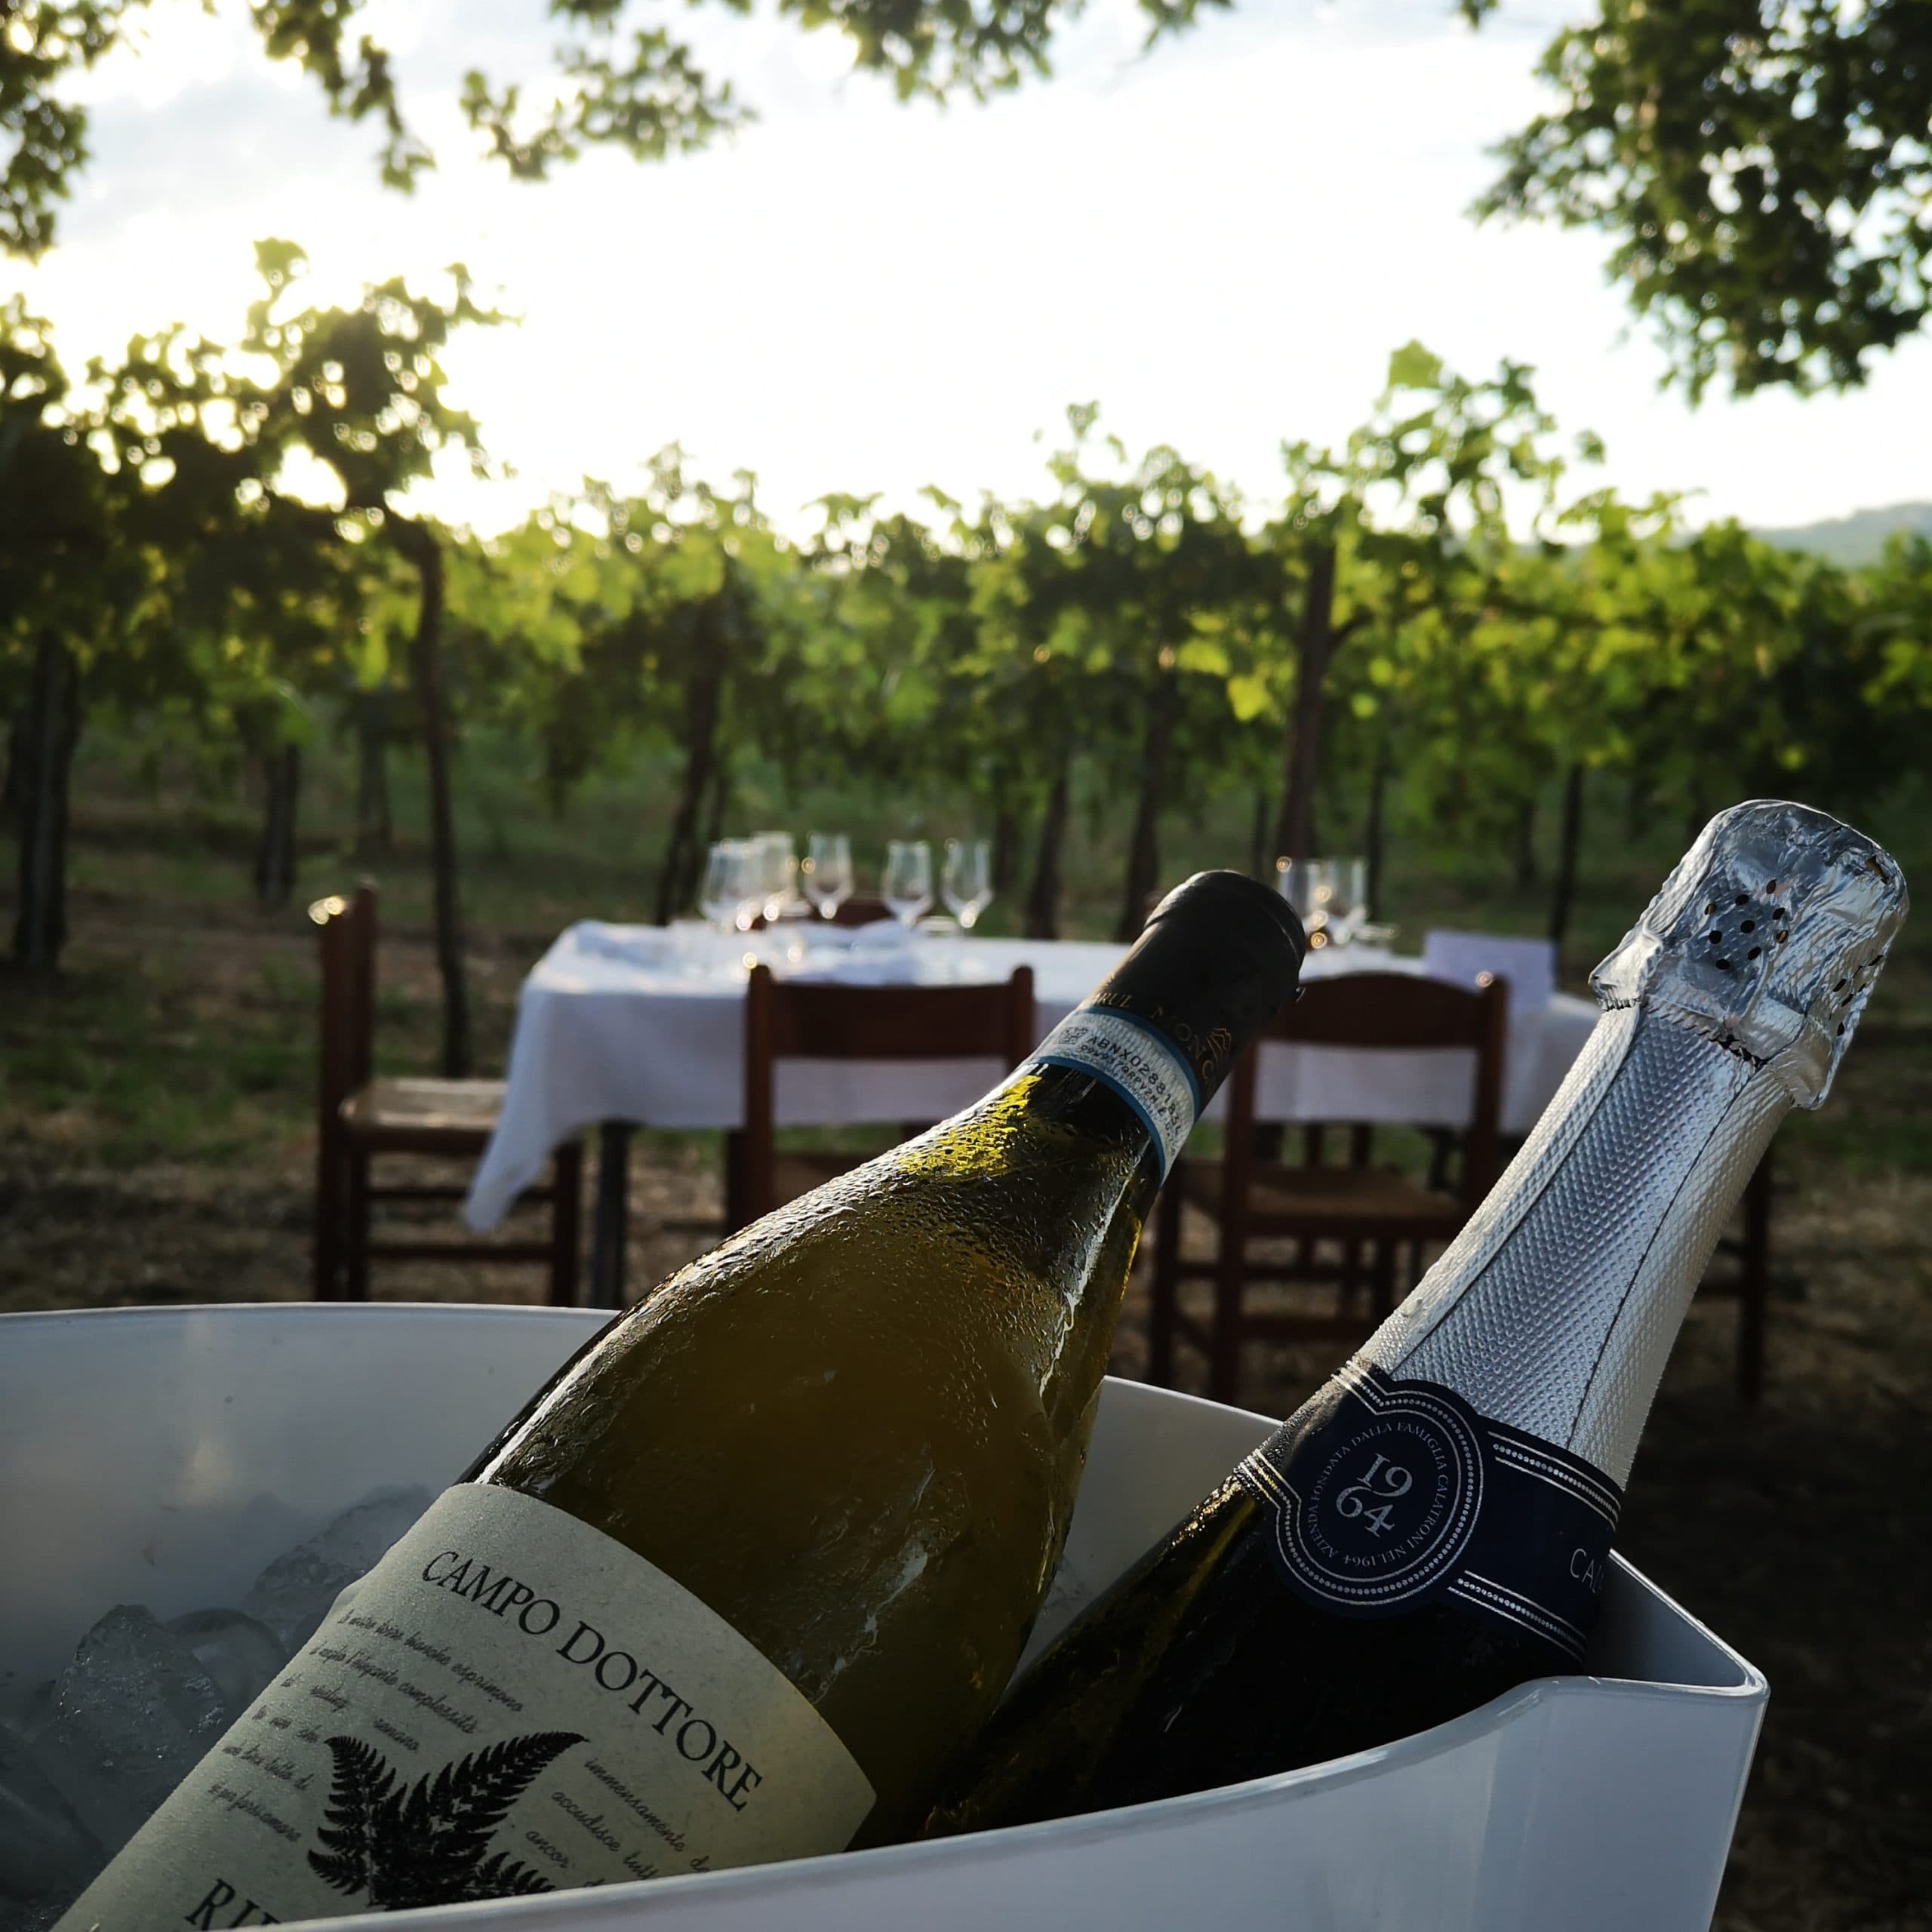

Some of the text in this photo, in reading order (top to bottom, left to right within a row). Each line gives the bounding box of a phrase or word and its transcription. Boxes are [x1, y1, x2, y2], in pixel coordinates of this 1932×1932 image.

[1307, 1421, 1450, 1567] AZIENDA FONDATA DALLA FAMIGLIA CALATRONI NEL 1964
[1335, 1485, 1395, 1538] 64
[1356, 1451, 1413, 1497] 19
[422, 1551, 763, 1812] CAMPO DOTTORE
[551, 1791, 621, 1852] accudisce
[584, 1758, 686, 1852] immensamente
